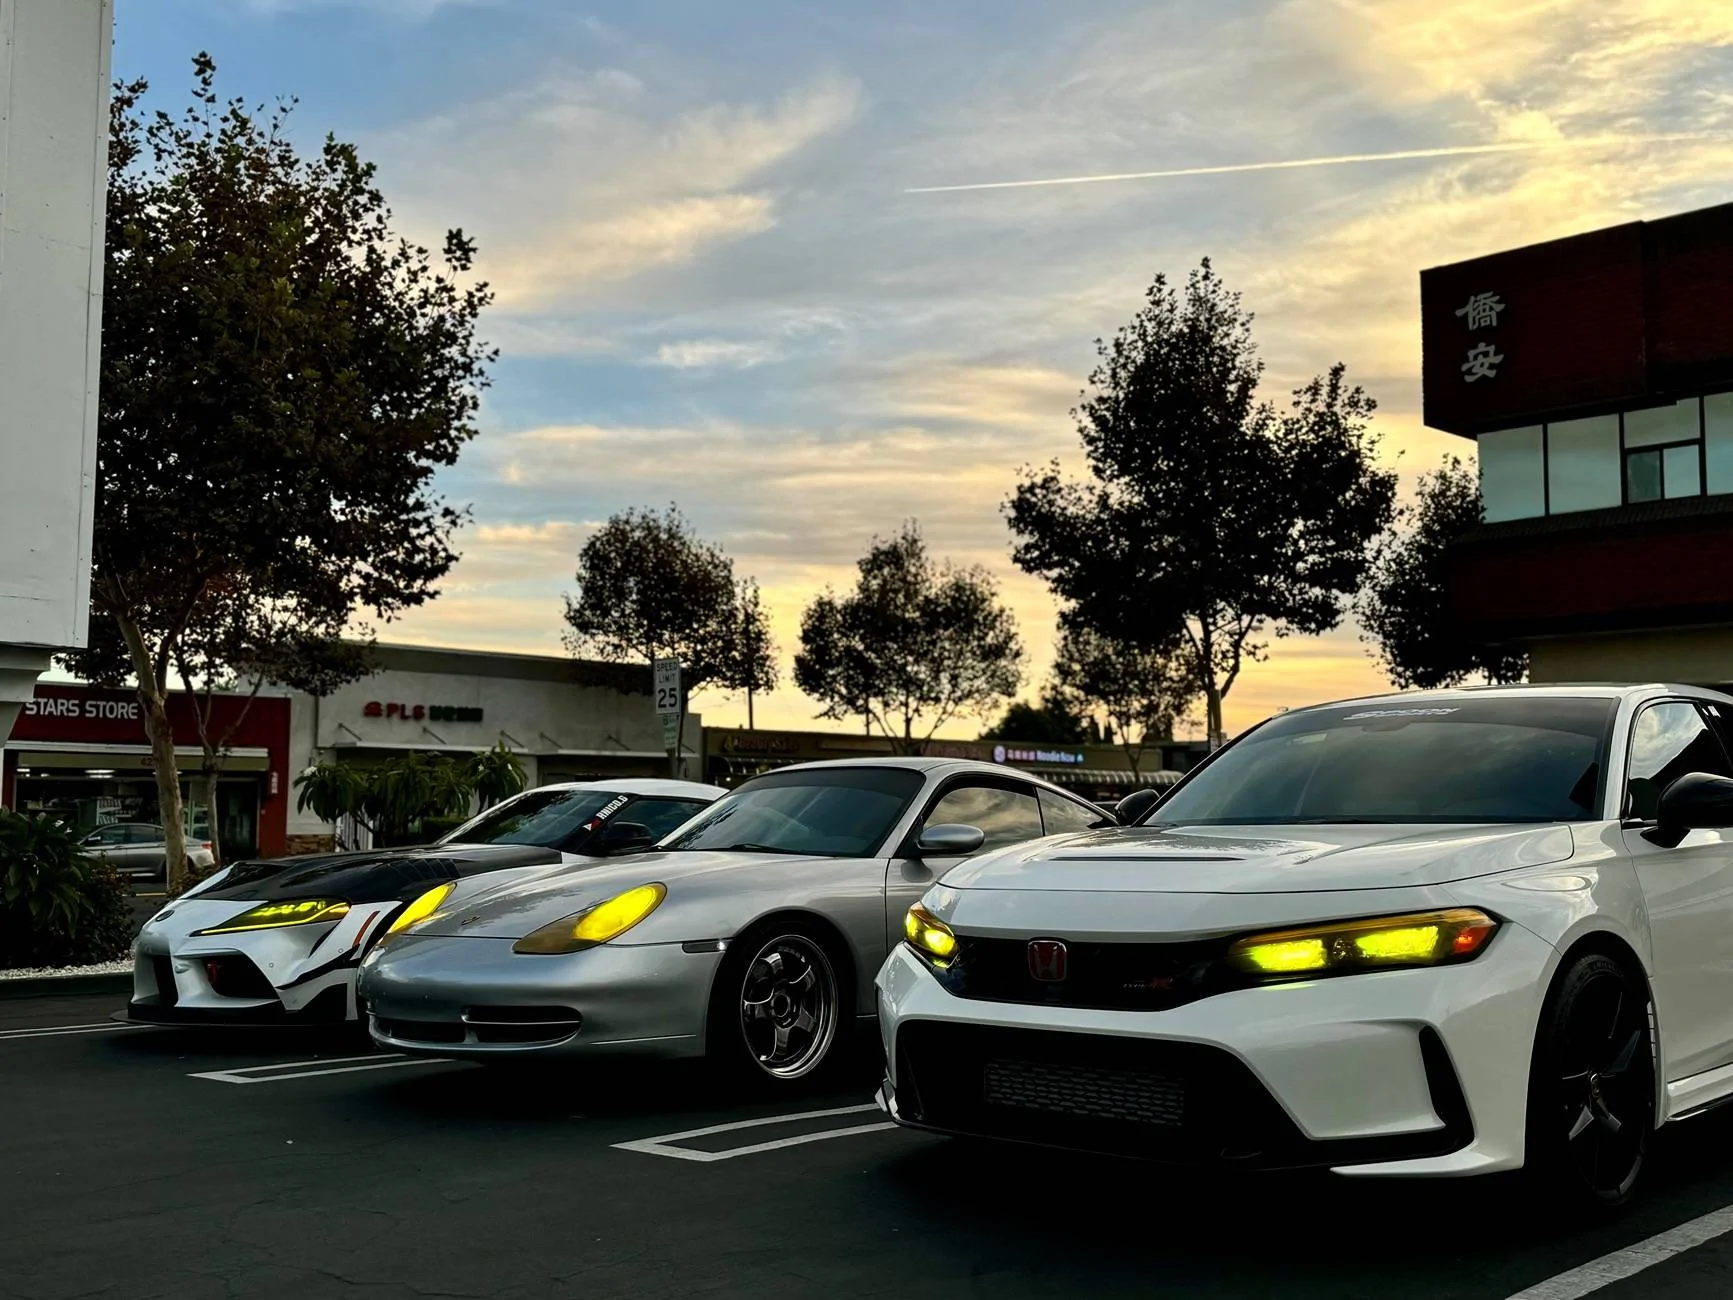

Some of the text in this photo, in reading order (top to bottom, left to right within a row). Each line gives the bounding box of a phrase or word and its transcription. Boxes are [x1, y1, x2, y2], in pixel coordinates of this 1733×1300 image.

[1455, 291, 1506, 383] 僑安
[656, 661, 678, 672] SPEED
[658, 673, 677, 684] LIMIT
[657, 687, 678, 708] 25
[25, 698, 138, 719] STARS STORE
